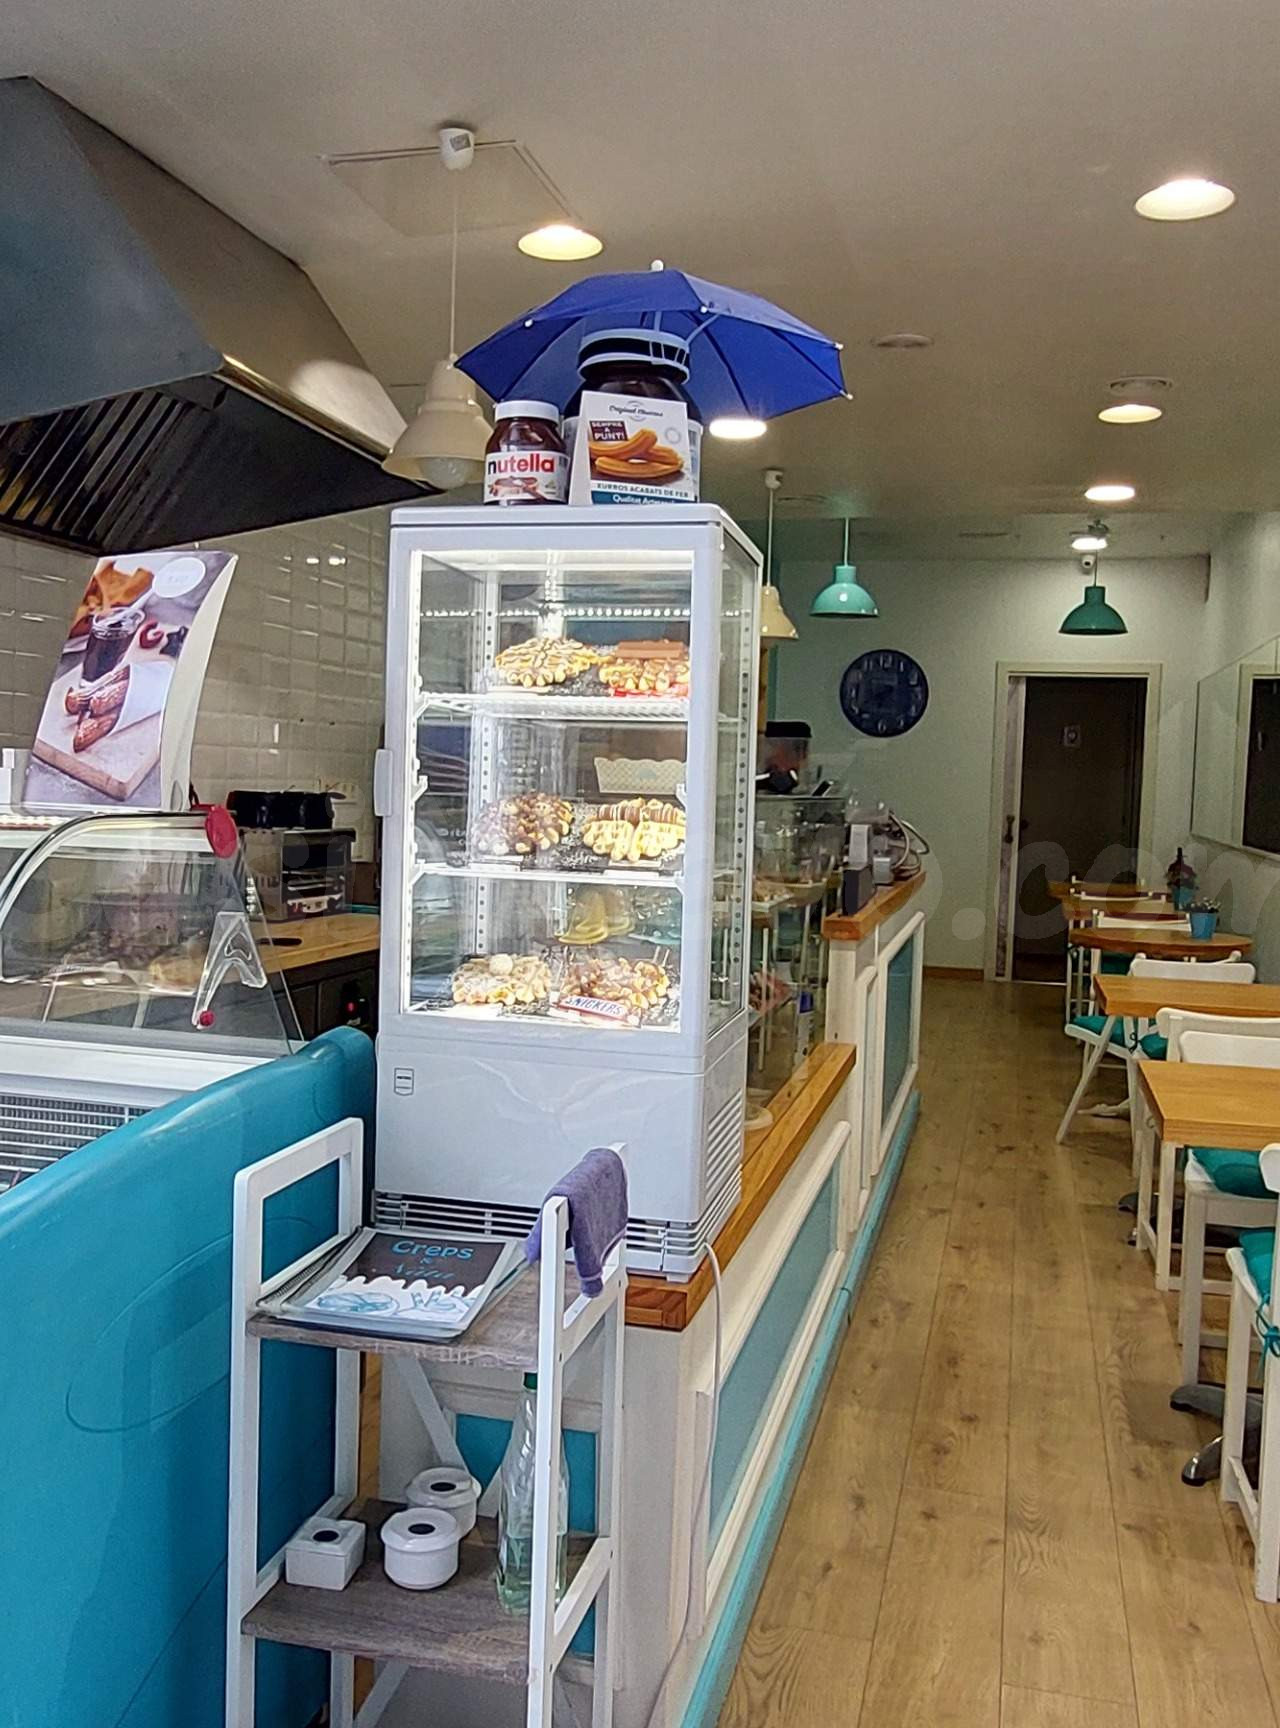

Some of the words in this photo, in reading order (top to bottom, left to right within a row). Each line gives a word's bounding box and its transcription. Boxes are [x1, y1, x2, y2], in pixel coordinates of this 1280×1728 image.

[488, 452, 555, 474] nutella
[565, 996, 622, 1016] SNICKERS
[392, 1240, 474, 1260] Creps
